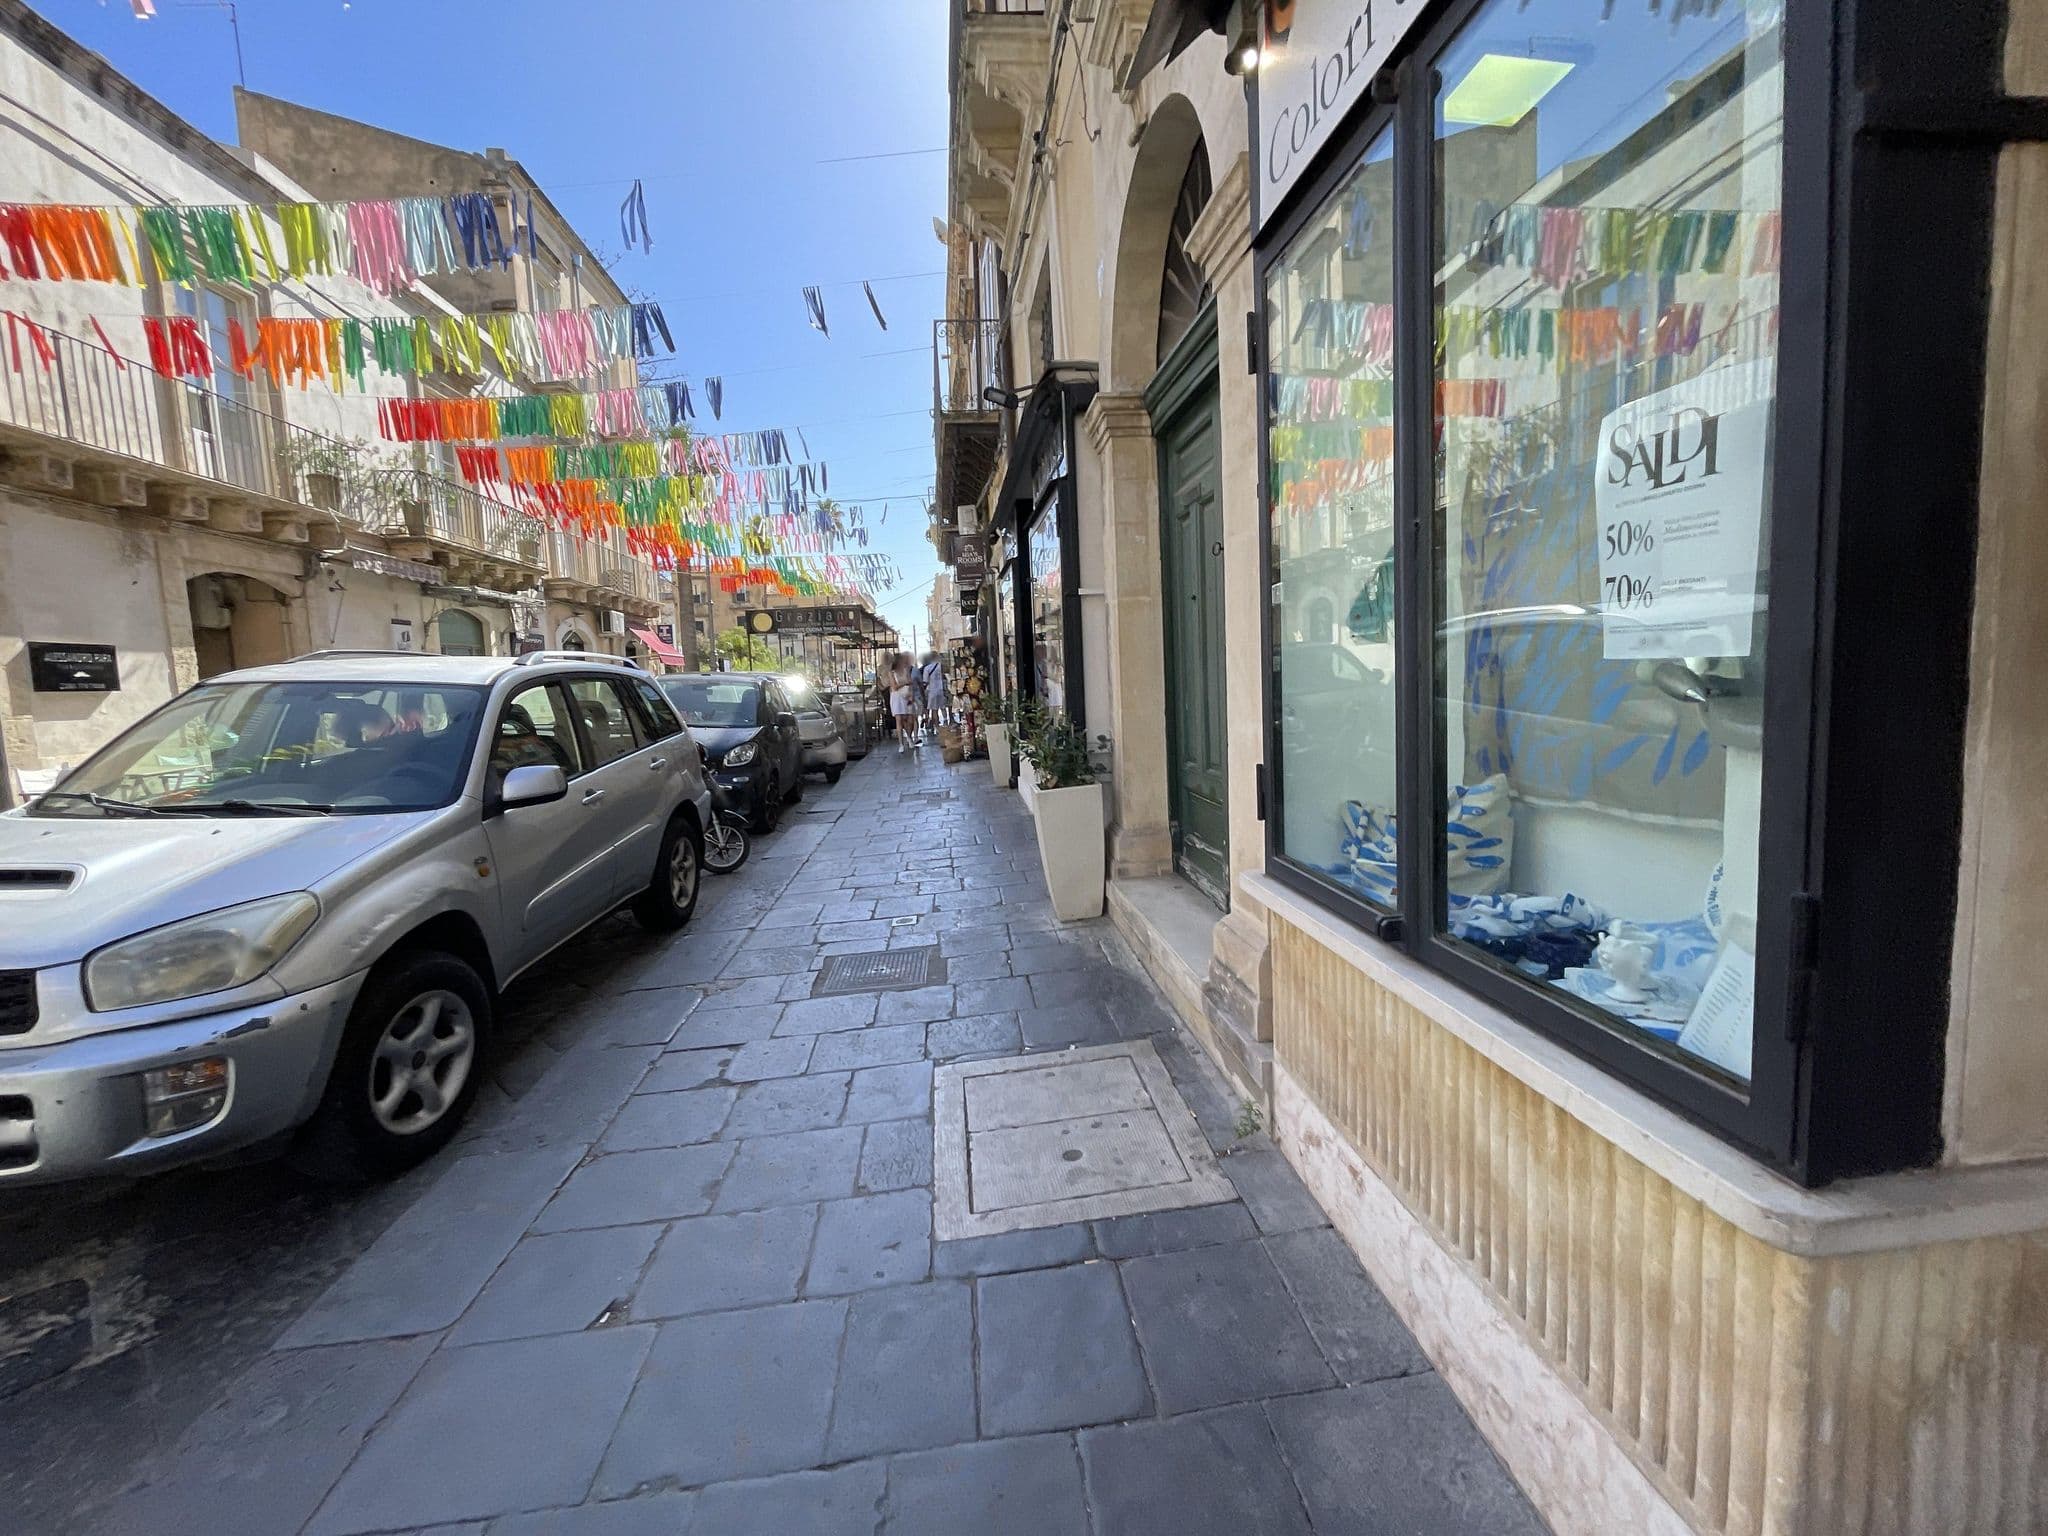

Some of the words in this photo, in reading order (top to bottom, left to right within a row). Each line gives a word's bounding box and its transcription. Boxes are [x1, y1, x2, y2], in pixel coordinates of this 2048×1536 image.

[1268, 0, 1376, 185] Colori
[1608, 407, 1728, 491] SALDI
[957, 555, 983, 564] ROOMS
[1606, 519, 1654, 560] 50%
[1605, 574, 1653, 611] 70%
